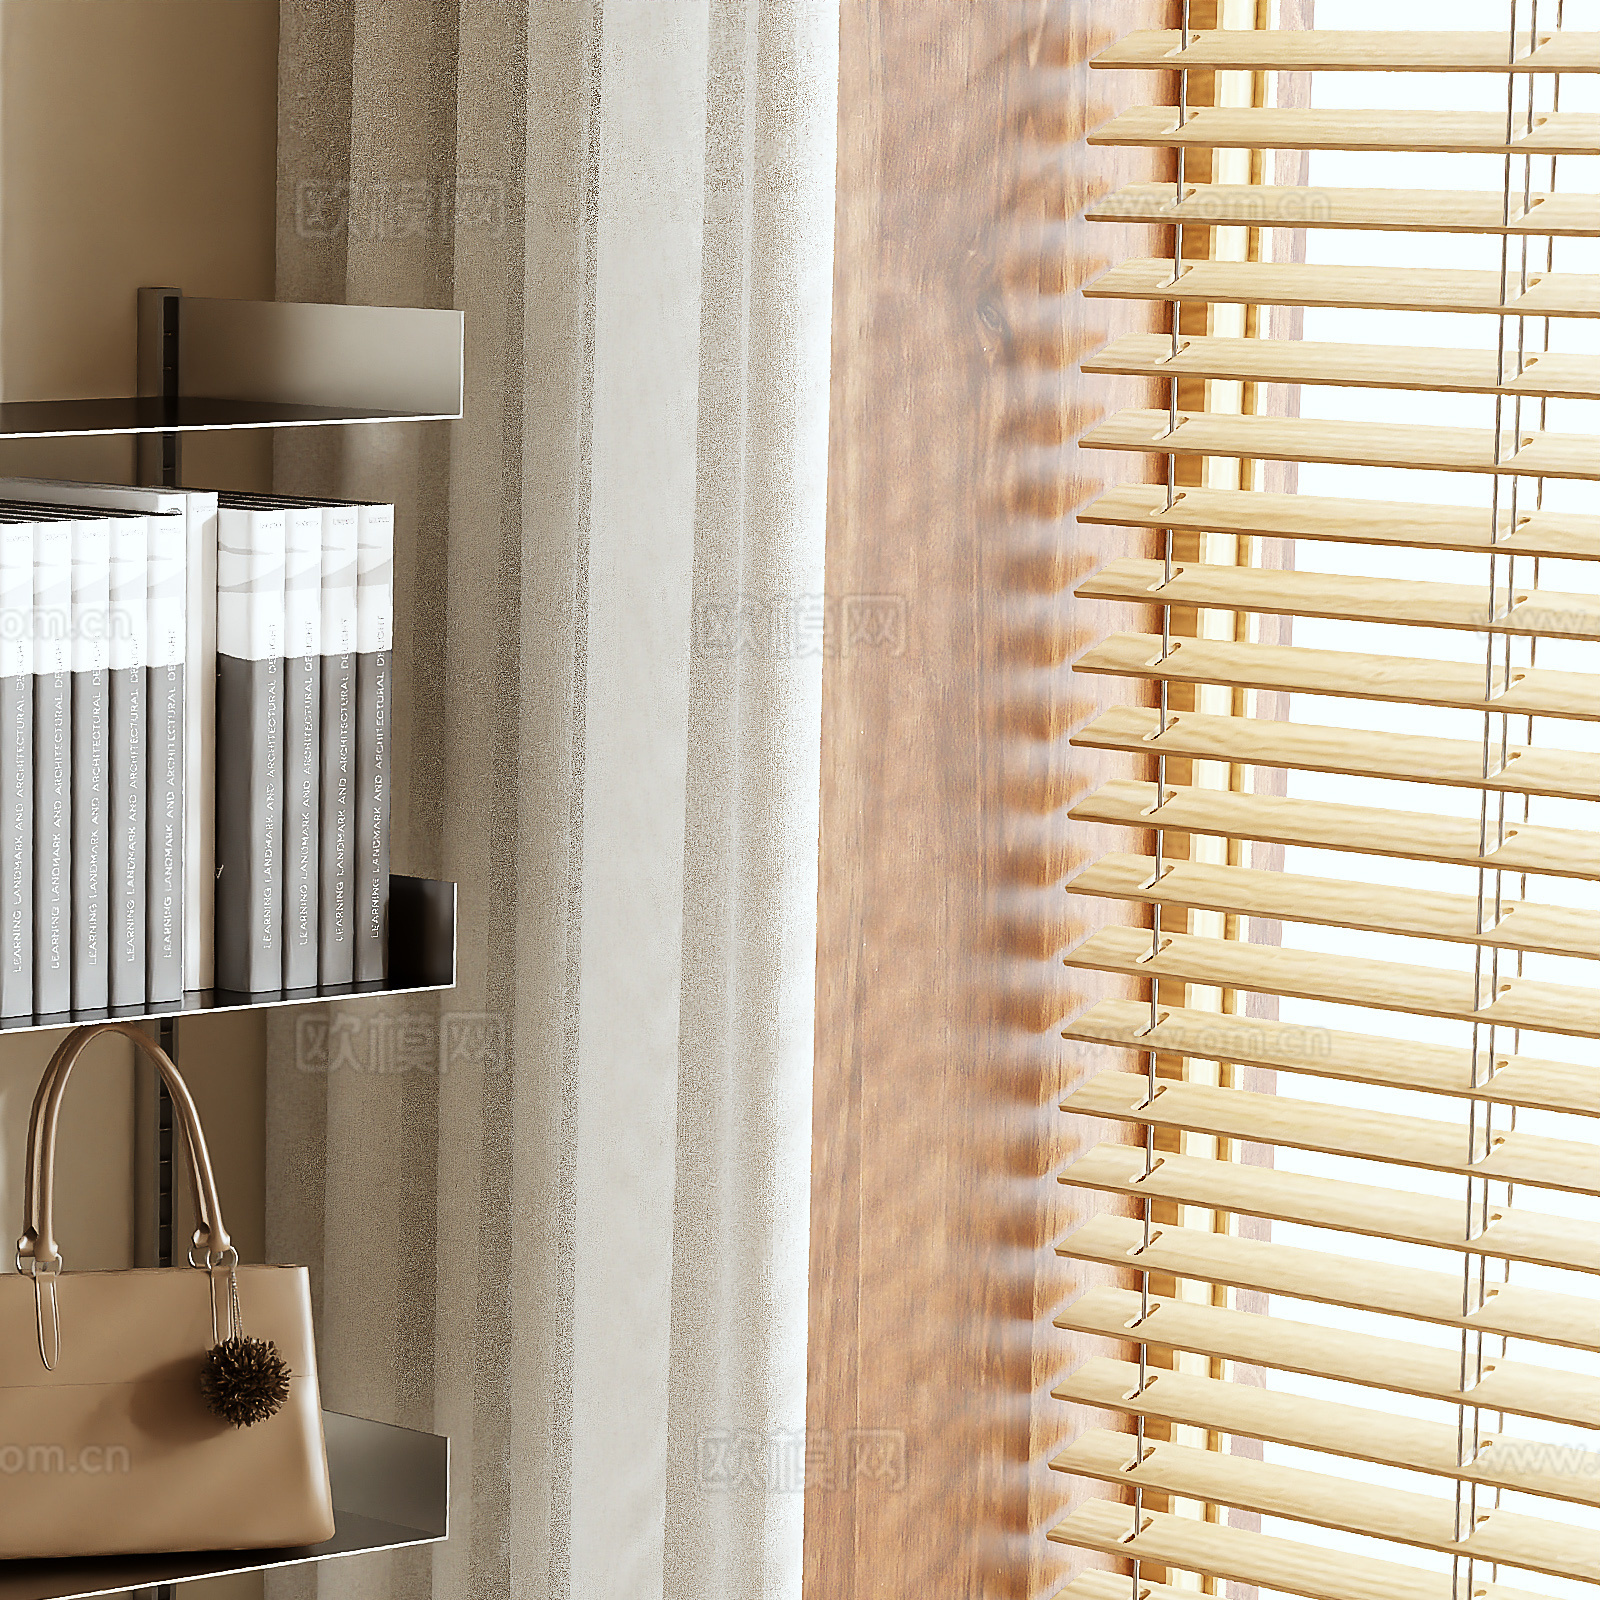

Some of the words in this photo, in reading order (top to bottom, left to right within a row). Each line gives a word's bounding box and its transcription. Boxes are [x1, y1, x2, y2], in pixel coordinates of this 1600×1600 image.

[14, 804, 24, 830] AND
[52, 801, 62, 827] AND
[90, 798, 99, 824] AND
[128, 795, 137, 821] AND
[166, 792, 175, 818] AND
[266, 783, 275, 810] AND
[301, 781, 311, 807] AND
[337, 778, 347, 805] AND
[373, 775, 382, 801] AND
[13, 836, 23, 905] LANDMARK
[52, 833, 61, 902] LANDMARK
[89, 830, 99, 898] LANDMARK
[127, 827, 136, 894] LANDMARK
[164, 824, 174, 891] LANDMARK
[264, 815, 273, 882] LANDMARK
[300, 813, 310, 879] LANDMARK
[336, 810, 346, 876] LANDMARK
[372, 807, 382, 873] LANDMARK
[51, 907, 60, 969] LEARNING
[88, 903, 98, 965] LEARNING
[126, 900, 135, 962] LEARNING
[163, 897, 172, 958] LEARNING
[263, 887, 272, 949] LEARNING
[299, 884, 309, 945] LEARNING
[335, 882, 344, 942] LEARNING
[371, 878, 380, 938] LEARNING
[12, 910, 22, 972] LEARNING
